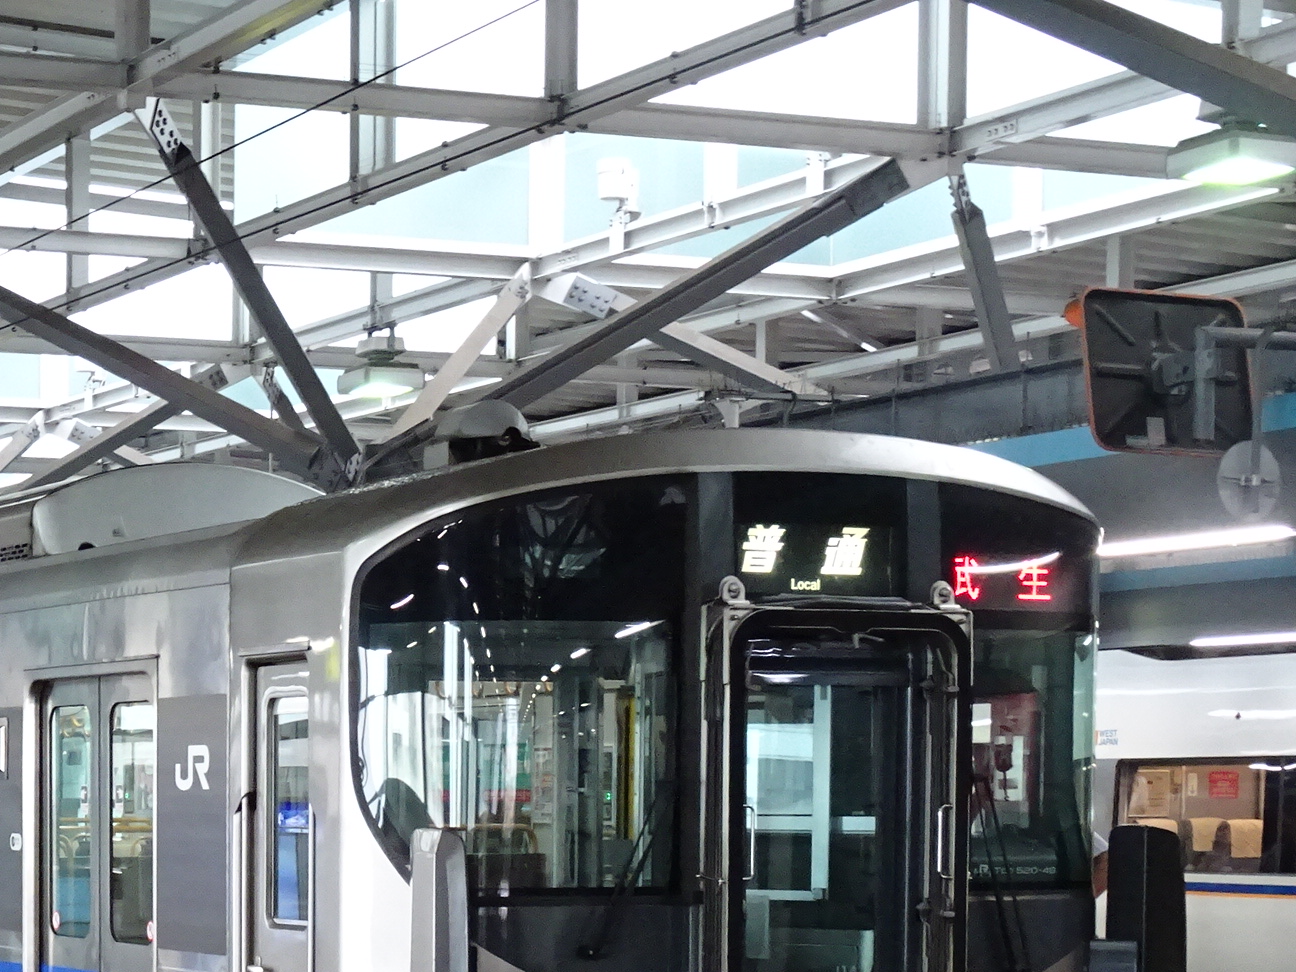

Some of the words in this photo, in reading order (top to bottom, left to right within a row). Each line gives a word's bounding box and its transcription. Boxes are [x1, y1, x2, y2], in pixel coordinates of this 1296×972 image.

[741, 524, 871, 575] 普通
[790, 577, 821, 591] Local
[954, 556, 1051, 600] 武生
[174, 744, 210, 791] JR
